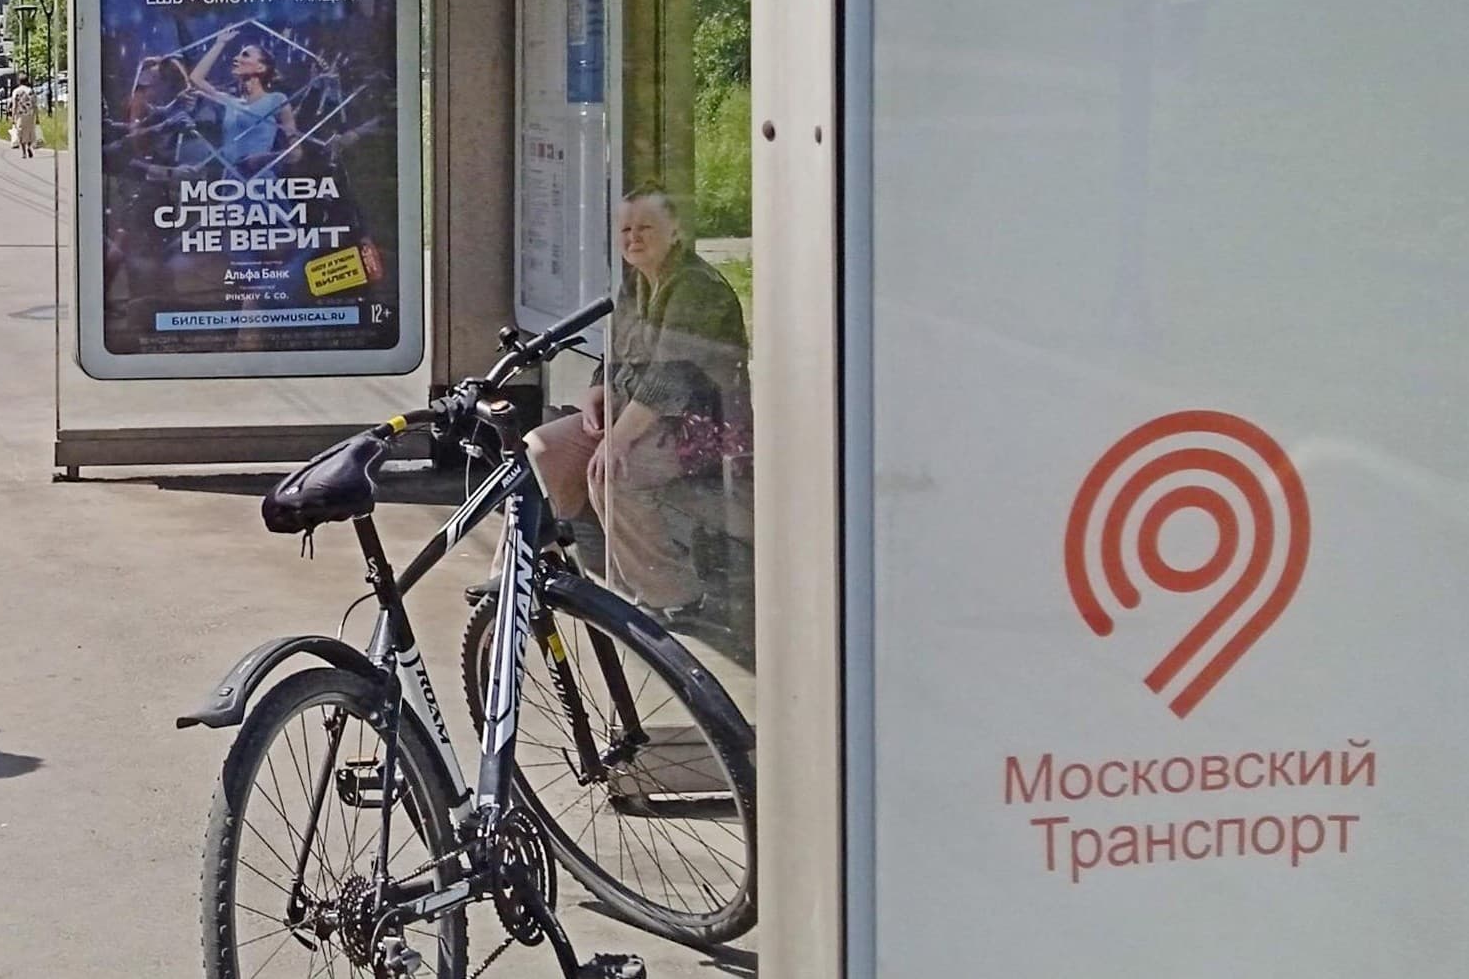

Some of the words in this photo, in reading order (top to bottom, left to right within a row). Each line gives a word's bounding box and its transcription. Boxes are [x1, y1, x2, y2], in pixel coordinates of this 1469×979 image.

[181, 177, 340, 202] МОСКВА
[154, 202, 307, 228] СЛЕЗАМ
[182, 229, 222, 253] НЕ
[230, 225, 350, 252] ВЕРИТ
[224, 268, 261, 283] Альфа
[261, 268, 290, 279] Банк
[315, 269, 359, 288] БИЛЕТЕ
[171, 316, 228, 326] БИЛЕТЫ:
[230, 311, 347, 324] MOSCOWMUSICAL.RU
[371, 303, 392, 324] 12+
[416, 669, 451, 744] ROAM
[1003, 737, 1377, 804] Московский
[1030, 813, 1361, 884] Транспорт
